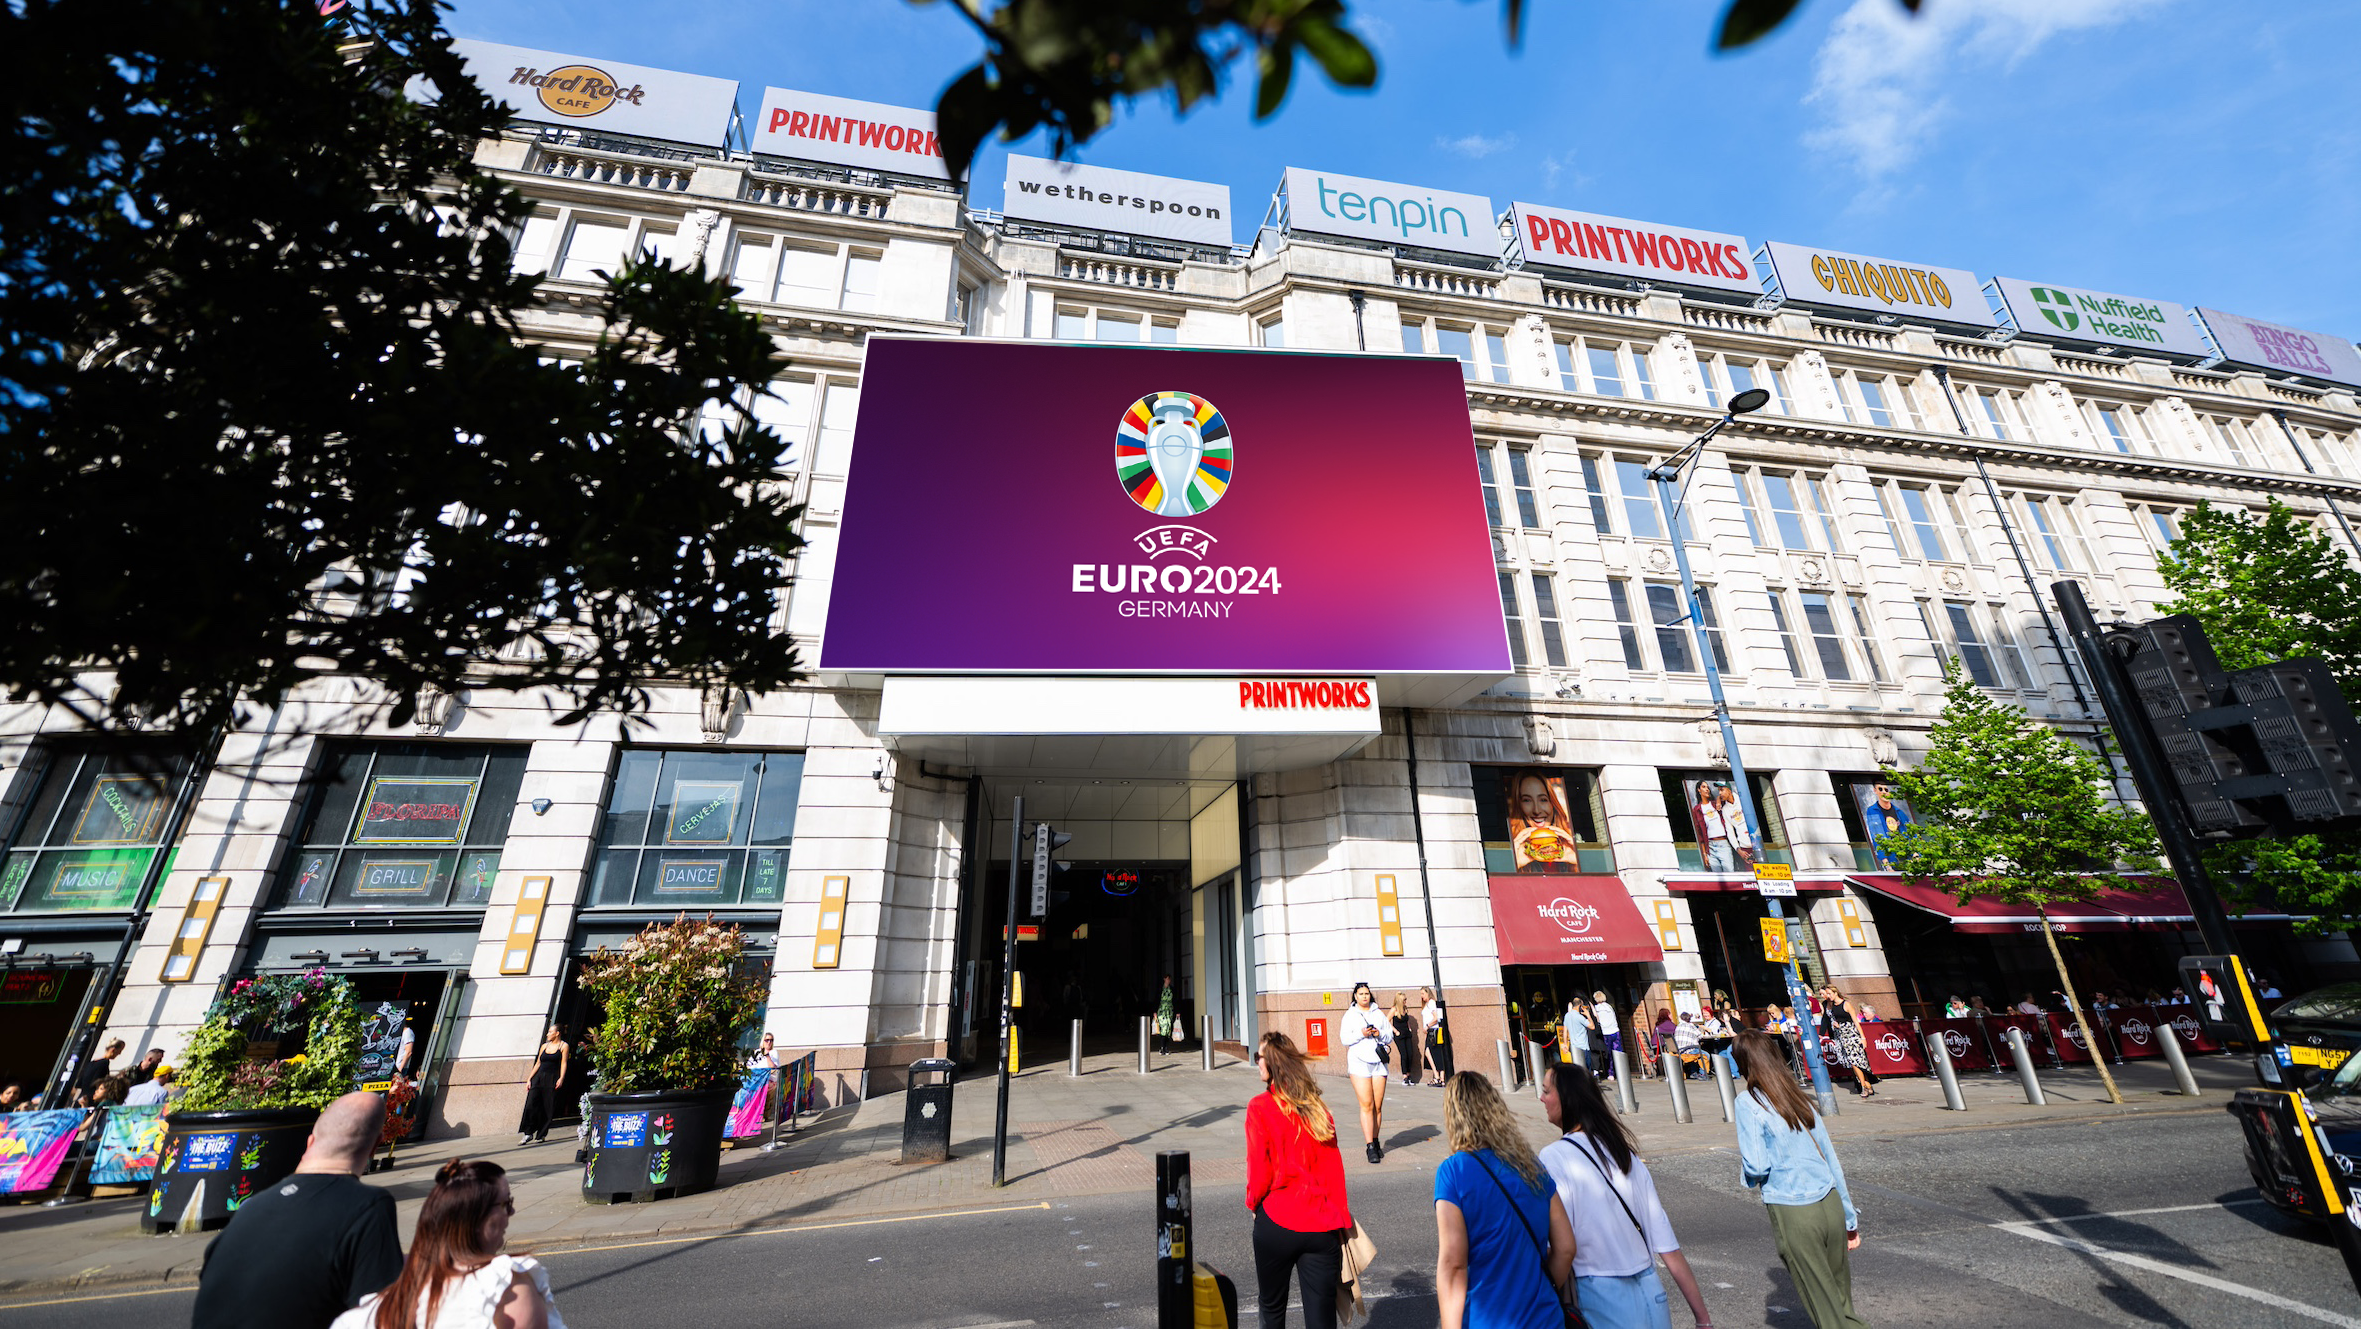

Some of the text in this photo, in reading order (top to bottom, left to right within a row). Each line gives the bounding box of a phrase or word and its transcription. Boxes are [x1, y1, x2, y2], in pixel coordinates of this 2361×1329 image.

[508, 66, 646, 106] Hard Rock
[556, 97, 591, 109] CAFE
[768, 107, 943, 158] PRINTWORK
[1018, 180, 1220, 220] wetherspoon
[1317, 177, 1469, 238] tenpin
[1526, 214, 1749, 281] PRINTWORKS
[1811, 253, 1952, 309] CHIQUITO
[2075, 293, 2166, 324] Nuffield
[2087, 314, 2165, 344] Health
[2245, 322, 2319, 356] BINGO
[2258, 343, 2333, 375] BALLS
[1138, 530, 1209, 556] UEFA
[1072, 564, 1282, 595] EURO2024
[1118, 600, 1234, 618] GERMANY
[1239, 681, 1371, 709] PRINTWORKS
[103, 786, 137, 833] COCKTAILS
[367, 801, 461, 821] FLORIPA
[679, 794, 726, 834] CERVEJAS
[61, 870, 117, 887] MUSIC
[370, 869, 418, 884] GRILL
[665, 868, 717, 883] DANCE
[760, 868, 774, 876] LATE
[1537, 904, 1601, 920] Hard Rock
[2023, 923, 2045, 932] ROCK
[1953, 1034, 1972, 1047] Rock
[2062, 1028, 2079, 1039] Hard
[2121, 1023, 2152, 1035] Hard Rock
[1874, 1039, 1910, 1051] Hard Rock
